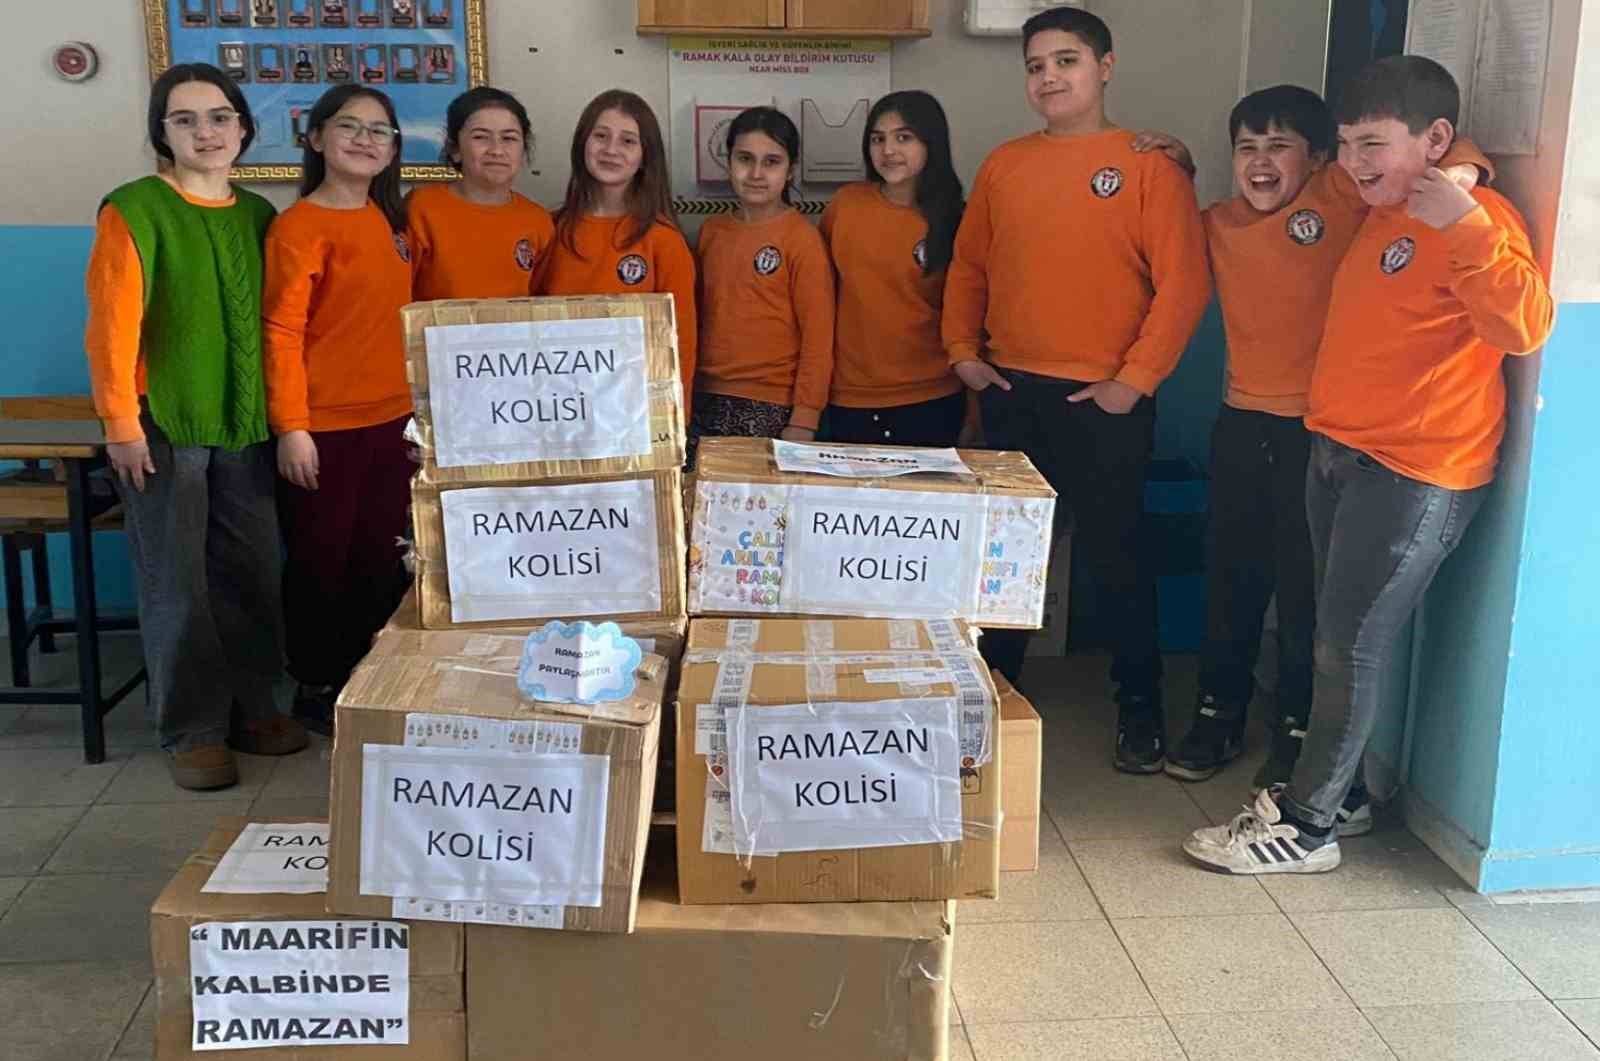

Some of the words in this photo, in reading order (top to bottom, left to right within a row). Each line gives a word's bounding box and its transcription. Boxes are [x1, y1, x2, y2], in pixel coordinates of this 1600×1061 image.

[682, 52, 721, 63] RAMAK
[723, 52, 752, 63] KALA
[754, 53, 780, 63] OLAY
[832, 53, 875, 64] KUTUSU
[457, 348, 616, 379] RAMAZAN
[490, 392, 587, 424] KOLİSİ
[472, 507, 630, 536] RAMAZAN
[812, 511, 961, 541] RAMAZAN
[508, 547, 602, 578] KOLİSİ
[838, 555, 928, 582] KOLİSİ
[756, 727, 928, 761] RAMAZAN
[393, 777, 573, 814] RAMAZAN
[795, 773, 898, 808] KOLİSİ
[263, 835, 329, 846] RAM
[427, 829, 534, 862] KOLİSİ
[282, 856, 328, 870] KO
[194, 969, 391, 996] KALBİNDE
